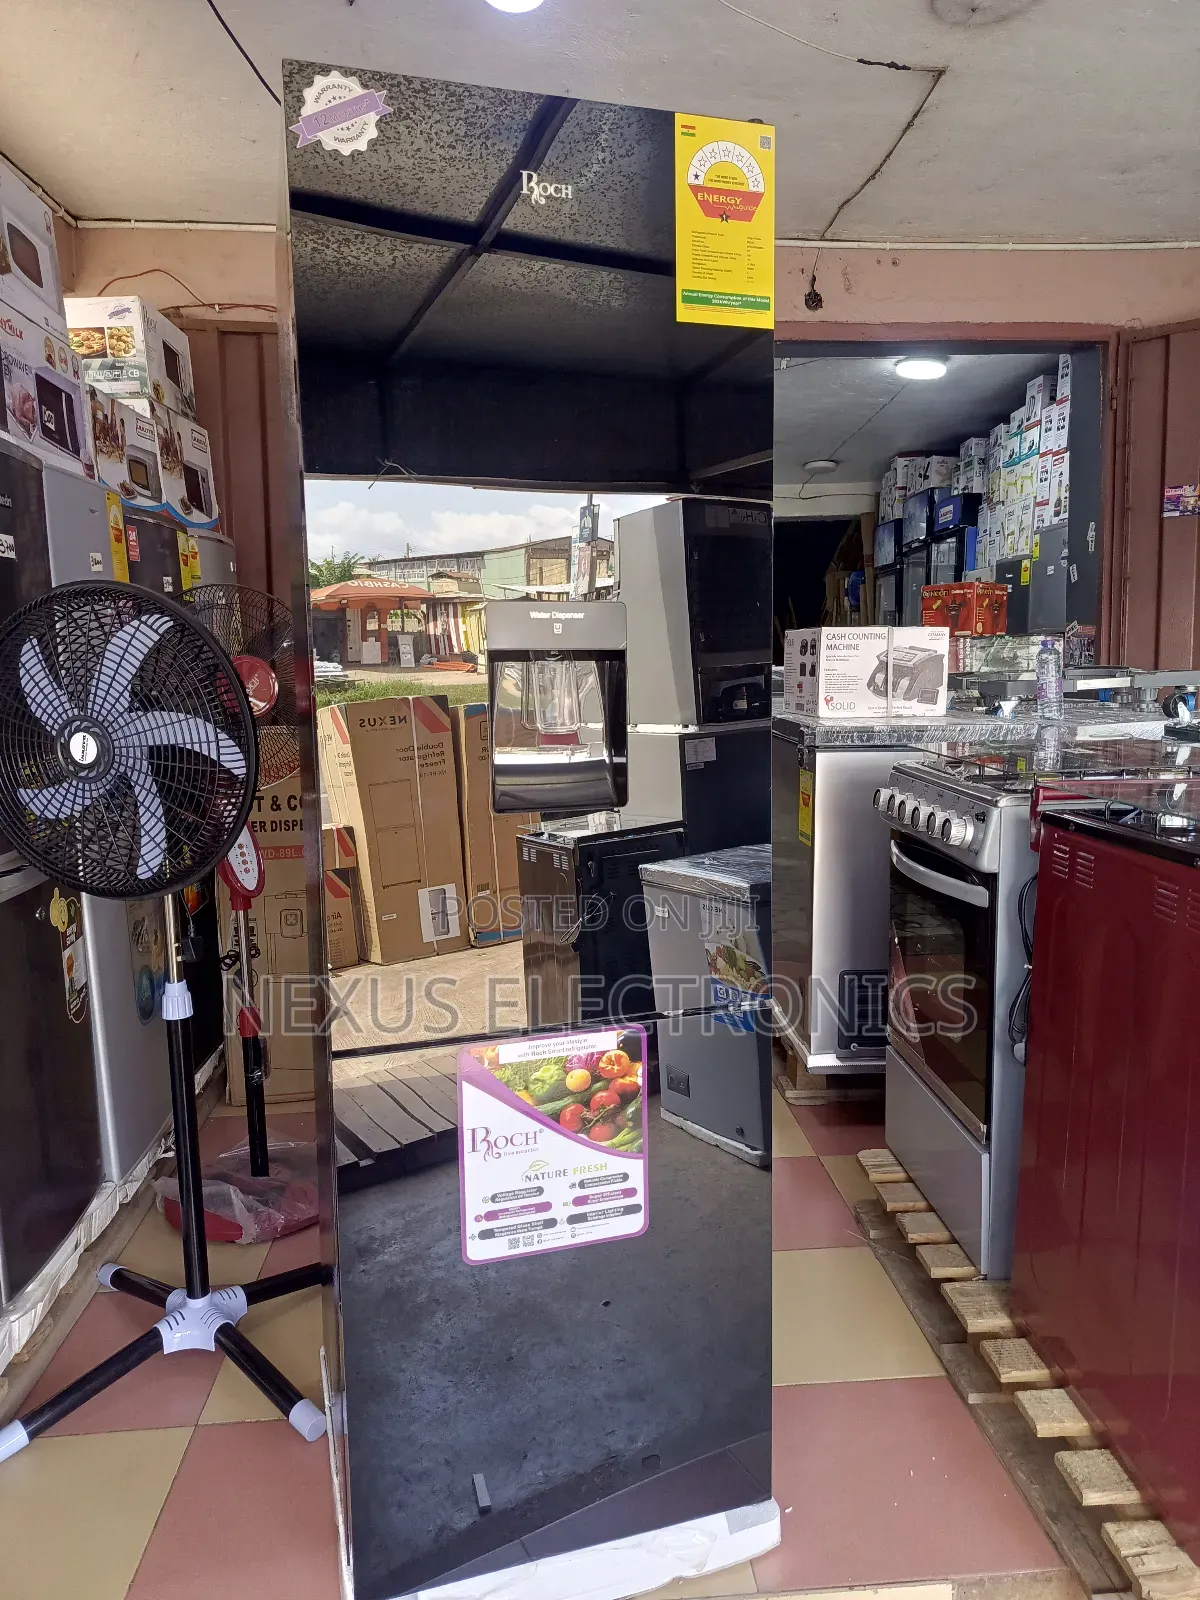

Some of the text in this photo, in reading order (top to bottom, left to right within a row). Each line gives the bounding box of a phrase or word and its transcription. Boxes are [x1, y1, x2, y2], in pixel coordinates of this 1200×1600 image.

[313, 83, 353, 104] WARRANTY
[313, 114, 330, 128] 12
[334, 120, 369, 144] WARRANTY
[519, 169, 573, 205] ROCH
[697, 192, 742, 204] ENERGY
[529, 611, 585, 620] Water Dispenser
[826, 632, 886, 641] CASH COUNTING
[825, 643, 860, 651] MACHINE
[830, 701, 856, 710] SOLID
[270, 794, 282, 812] &
[287, 794, 303, 812] C
[251, 819, 304, 833] ER DISPE
[528, 1042, 552, 1051] Improve
[566, 1038, 588, 1046] lifestyle
[547, 1047, 565, 1055] Smart
[503, 1147, 539, 1158] live smarter
[524, 1162, 608, 1183] NATURE FRESH
